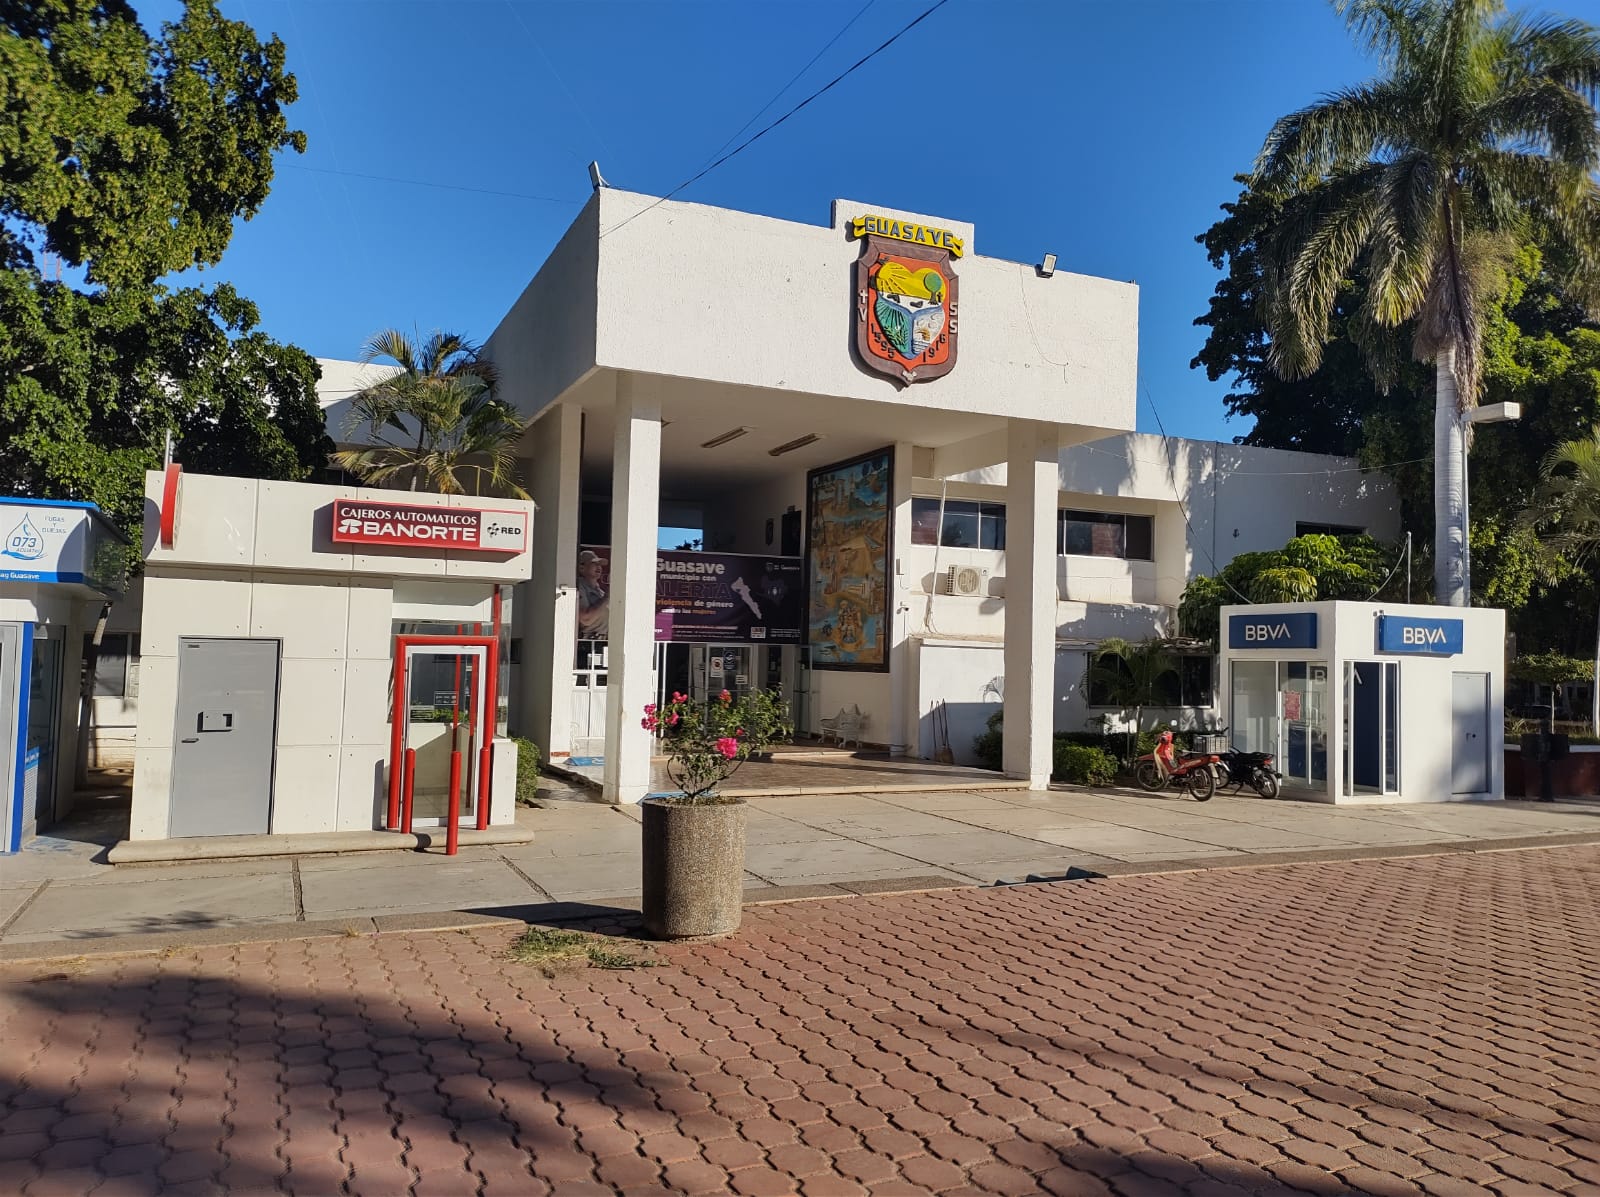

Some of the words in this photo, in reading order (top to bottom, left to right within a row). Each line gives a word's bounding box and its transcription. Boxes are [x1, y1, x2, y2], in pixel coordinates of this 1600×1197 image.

[865, 216, 954, 247] GUASAVE
[341, 507, 391, 520] CAJEROS
[394, 511, 477, 526] AUTOMATICOS
[363, 521, 477, 542] BANORTE
[501, 527, 521, 535] RED
[12, 536, 37, 548] 073
[656, 557, 726, 575] Guasave
[10, 571, 40, 580] Guasave
[660, 573, 700, 583] municipio
[1245, 622, 1291, 641] BBVA
[1403, 626, 1447, 645] BBVA
